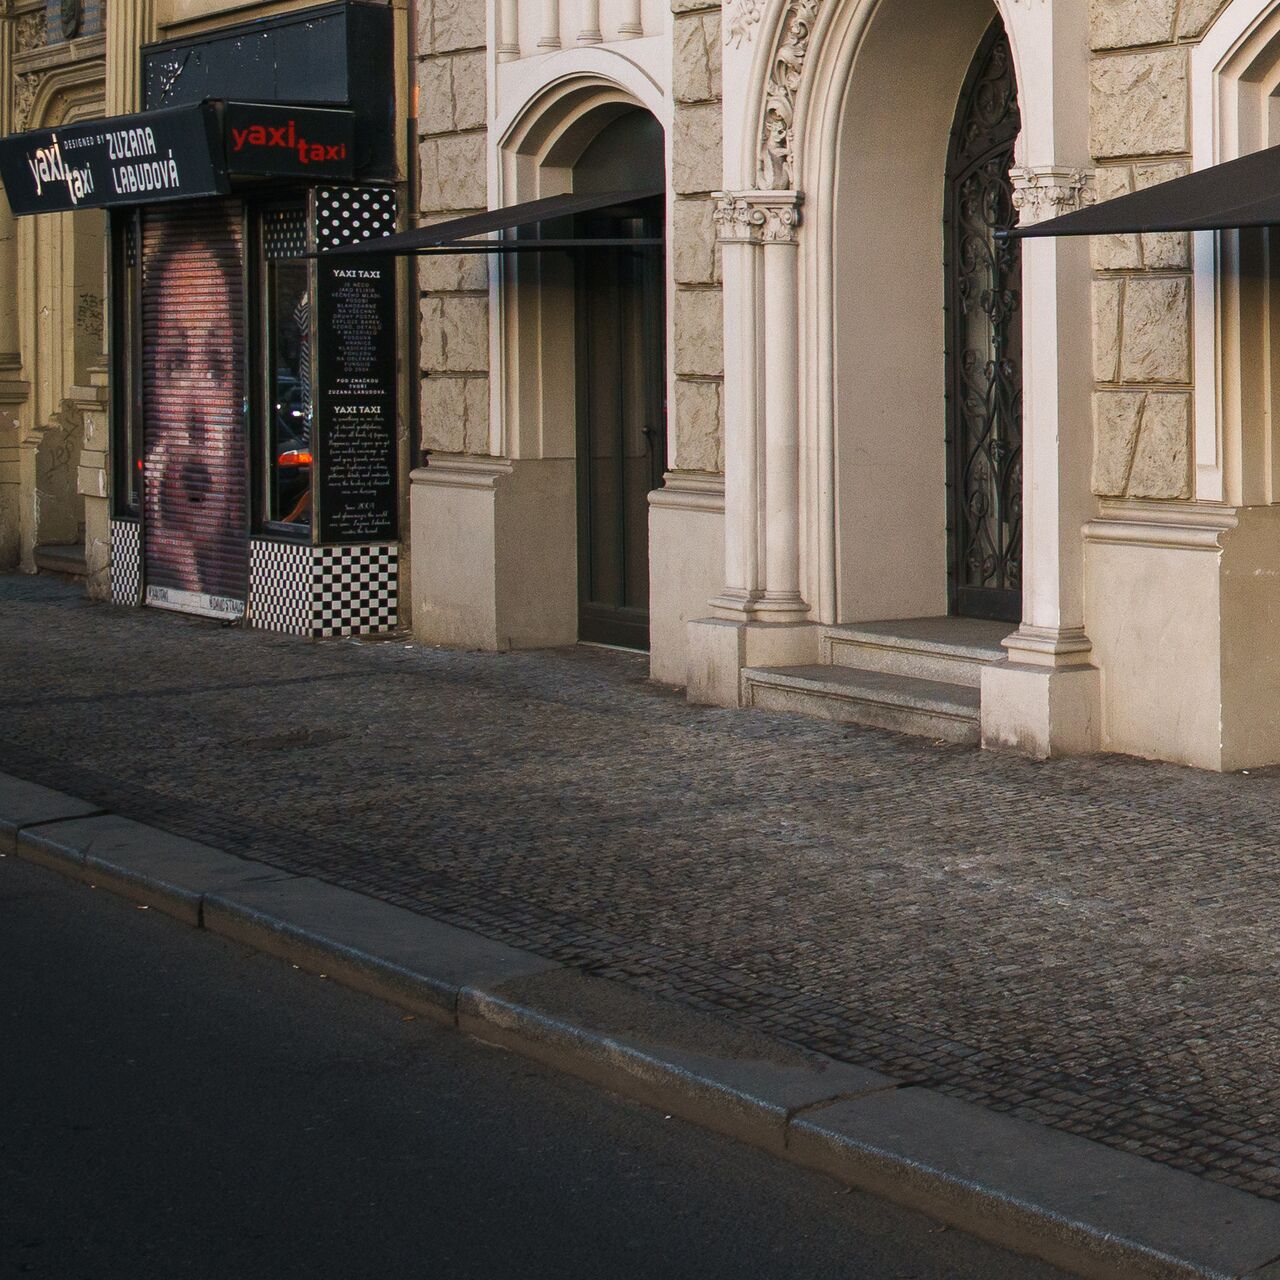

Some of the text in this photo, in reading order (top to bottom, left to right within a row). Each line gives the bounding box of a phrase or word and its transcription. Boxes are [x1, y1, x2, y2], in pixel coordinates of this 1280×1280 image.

[63, 134, 105, 150] DESIGNED BY
[105, 126, 157, 161] ZUZANA
[231, 118, 297, 152] yaxi
[298, 137, 348, 164] taxi
[26, 133, 65, 197] yaxi
[111, 149, 180, 195] LABUDOVÁ
[63, 162, 95, 205] taxi
[333, 269, 381, 279] YAXI TAXI
[334, 405, 381, 414] YAXI TAXI
